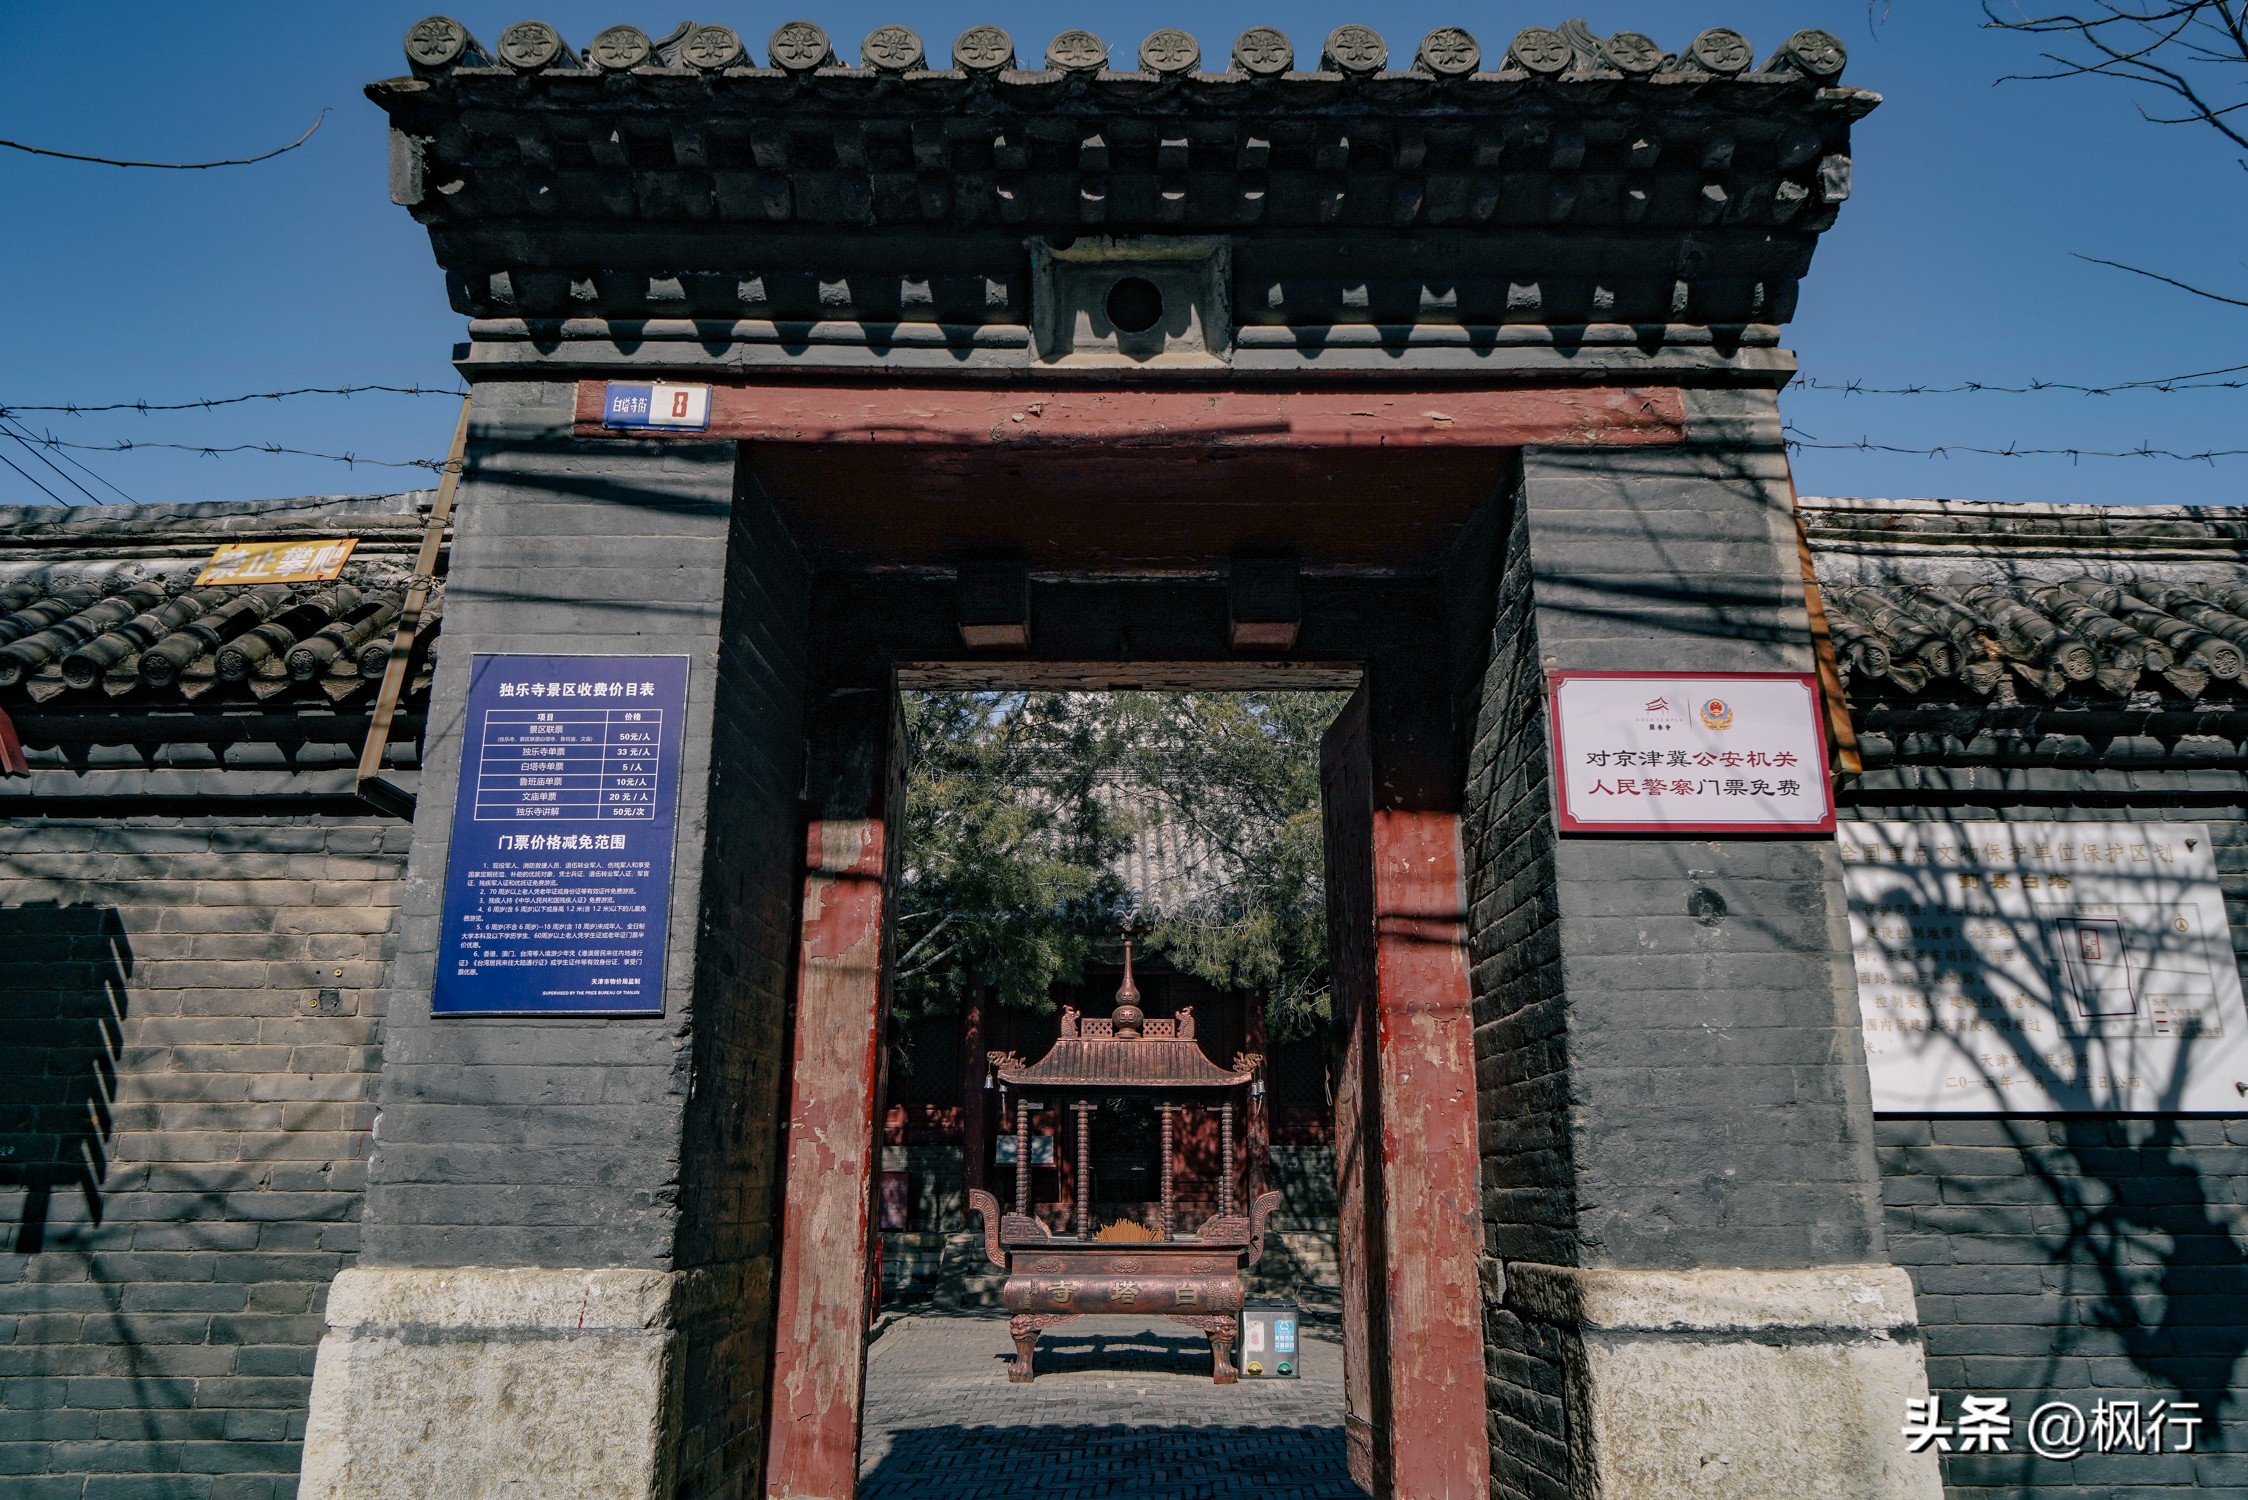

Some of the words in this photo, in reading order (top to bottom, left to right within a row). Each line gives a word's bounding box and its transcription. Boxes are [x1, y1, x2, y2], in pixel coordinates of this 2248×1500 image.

[613, 395, 647, 414] 白塔寺街
[672, 391, 689, 418] 8
[206, 545, 347, 580] 禁止攀爬
[499, 682, 656, 698] 独乐寺景区收费价目表
[537, 713, 554, 722] 项目
[624, 712, 642, 721] 价格
[529, 725, 564, 734] 景区联票
[619, 732, 651, 741] 50元/人
[522, 747, 566, 756] 独乐寺单票
[617, 748, 628, 756] 33
[1586, 750, 1799, 769] 对京津冀公安机关
[520, 762, 564, 771] 白塔寺单票
[519, 777, 563, 786] 鲁班庙单票
[616, 777, 647, 786] 10元/人
[1588, 778, 1801, 797] 人民警察门票免费
[522, 792, 557, 801] 文庙单票
[516, 807, 560, 817] 独乐寺讲解
[613, 807, 645, 816] 50元/次
[498, 834, 626, 850] 门票价格减免范围
[1840, 841, 2175, 864] 全国重点文物保护单位保护区划
[1957, 873, 2073, 890] 蓟县白塔
